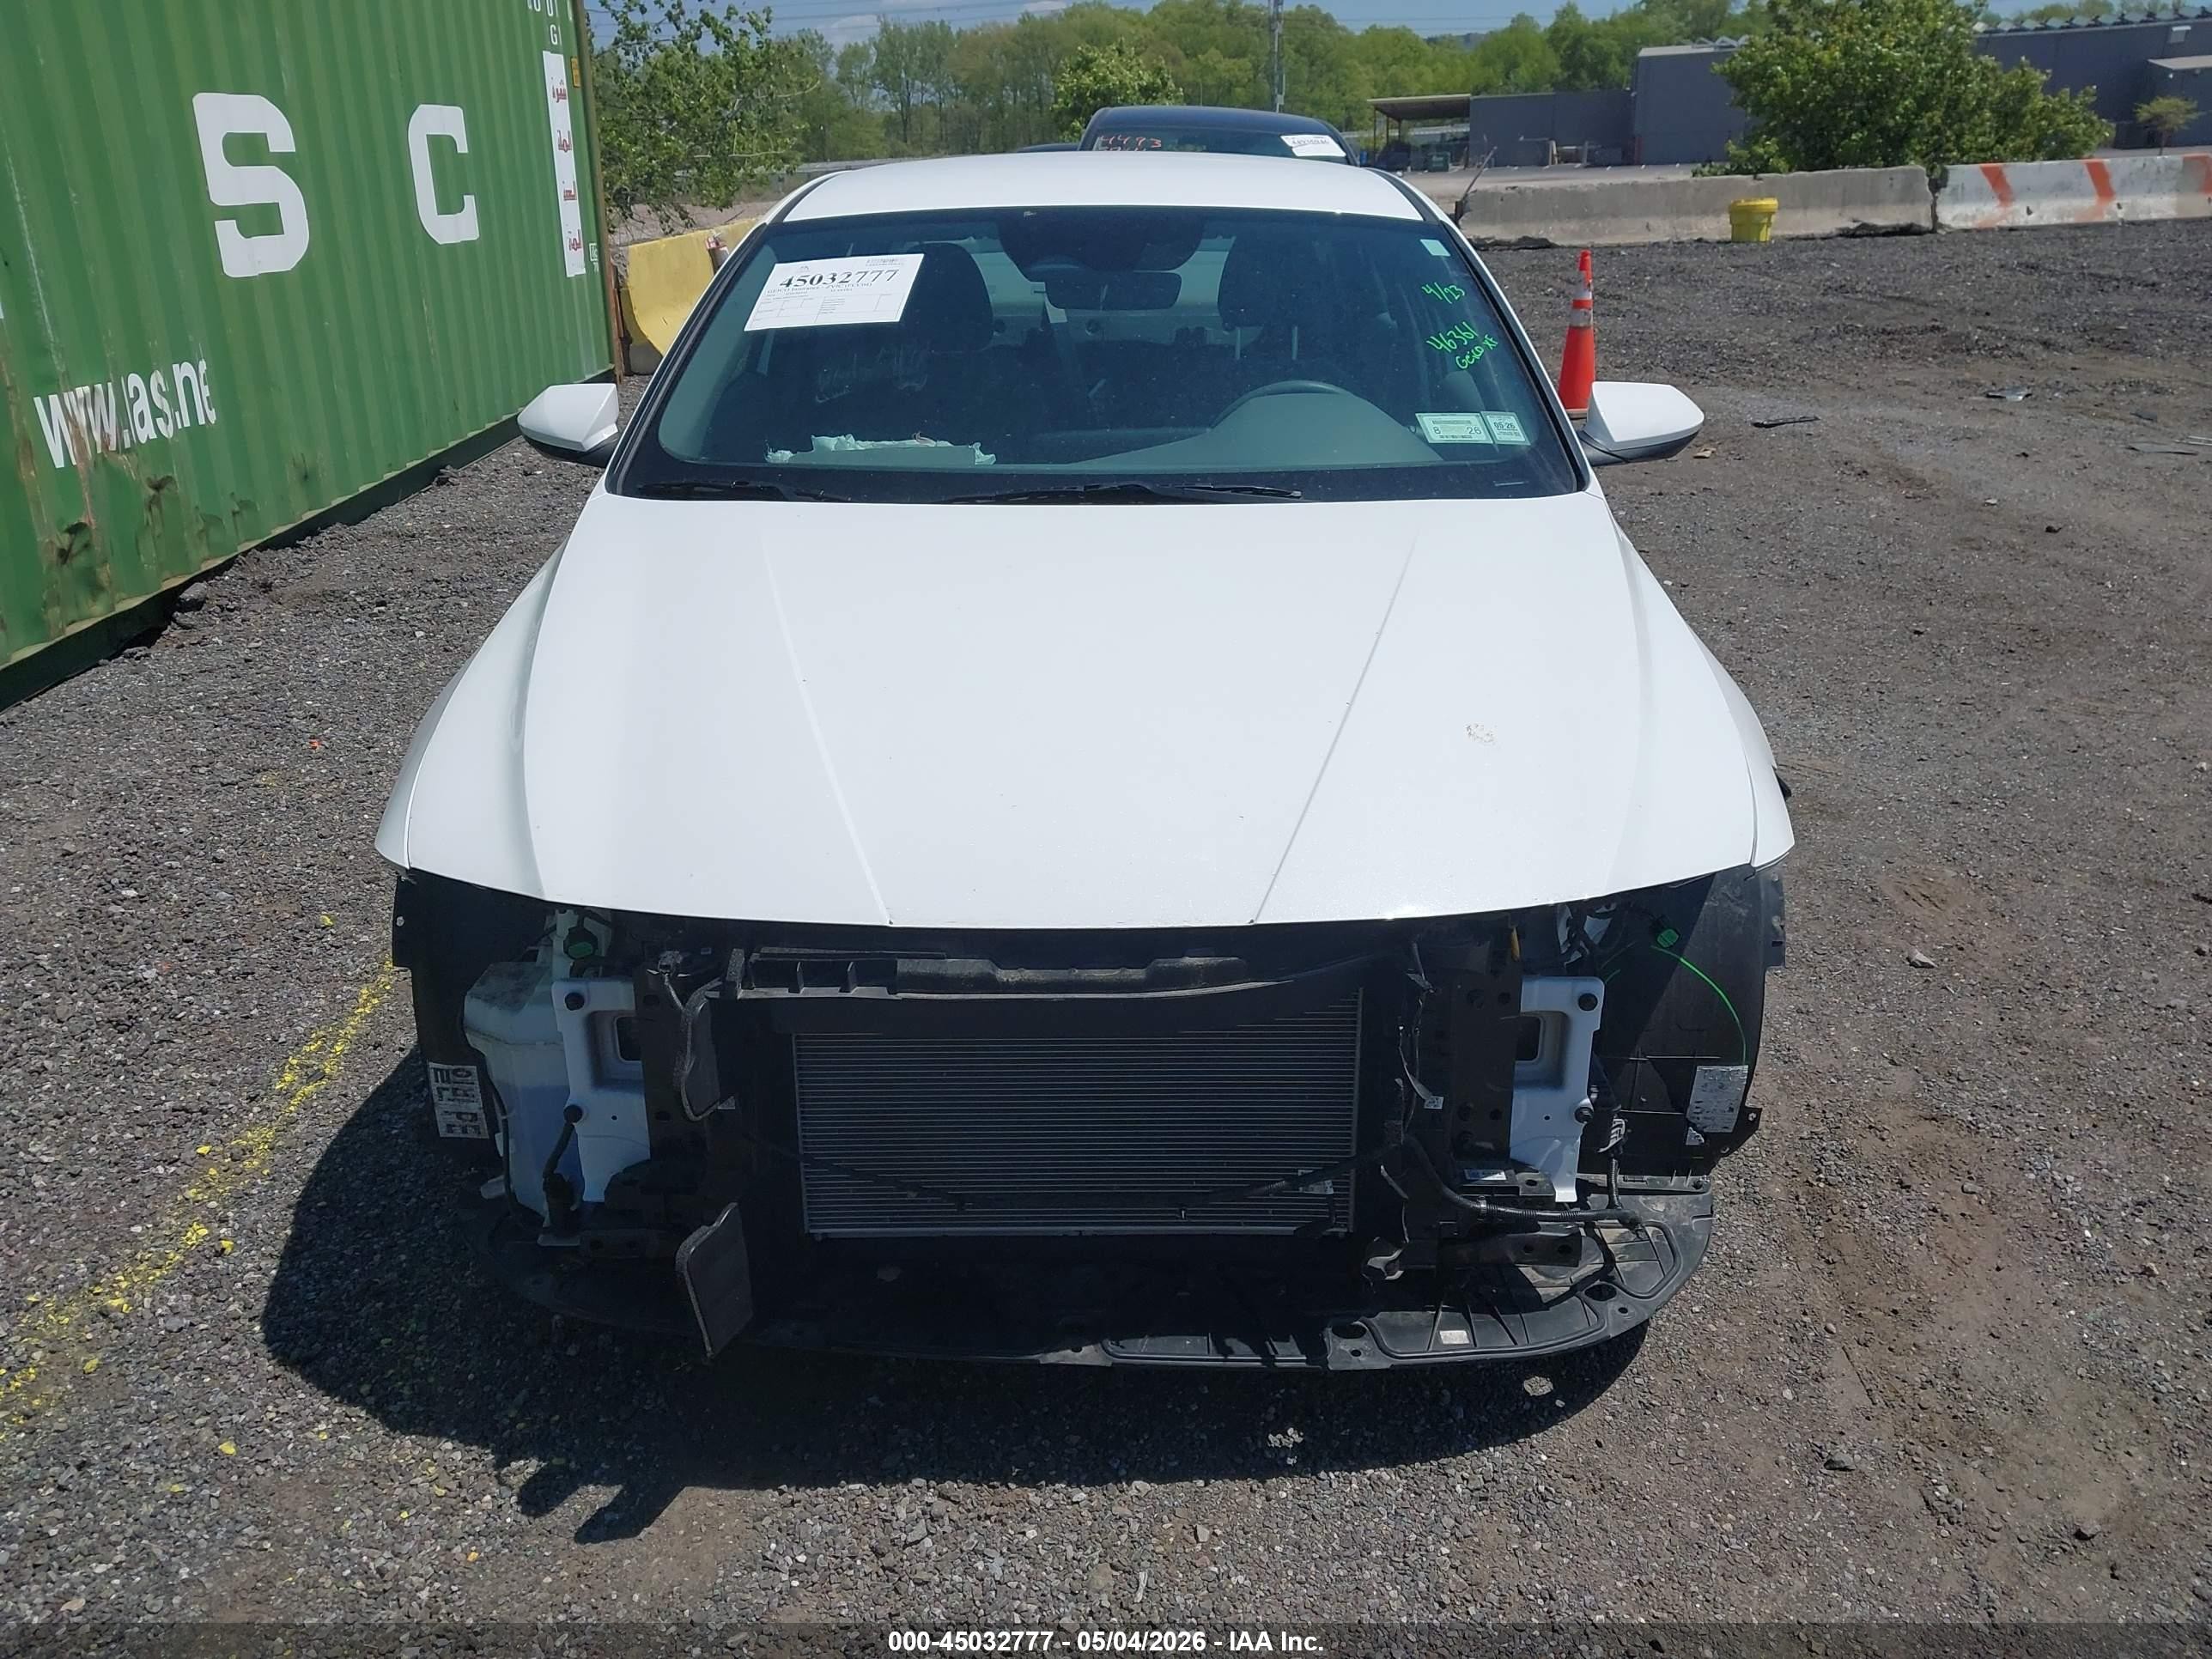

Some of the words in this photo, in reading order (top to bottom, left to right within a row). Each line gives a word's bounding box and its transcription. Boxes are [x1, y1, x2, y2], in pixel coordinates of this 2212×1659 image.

[192, 92, 310, 278] S
[407, 103, 480, 245] C
[779, 269, 900, 288] 45032777
[1421, 282, 1466, 304] 4/23
[1425, 321, 1479, 353] 46361
[1431, 426, 1441, 434] 8
[1466, 426, 1481, 434] 26
